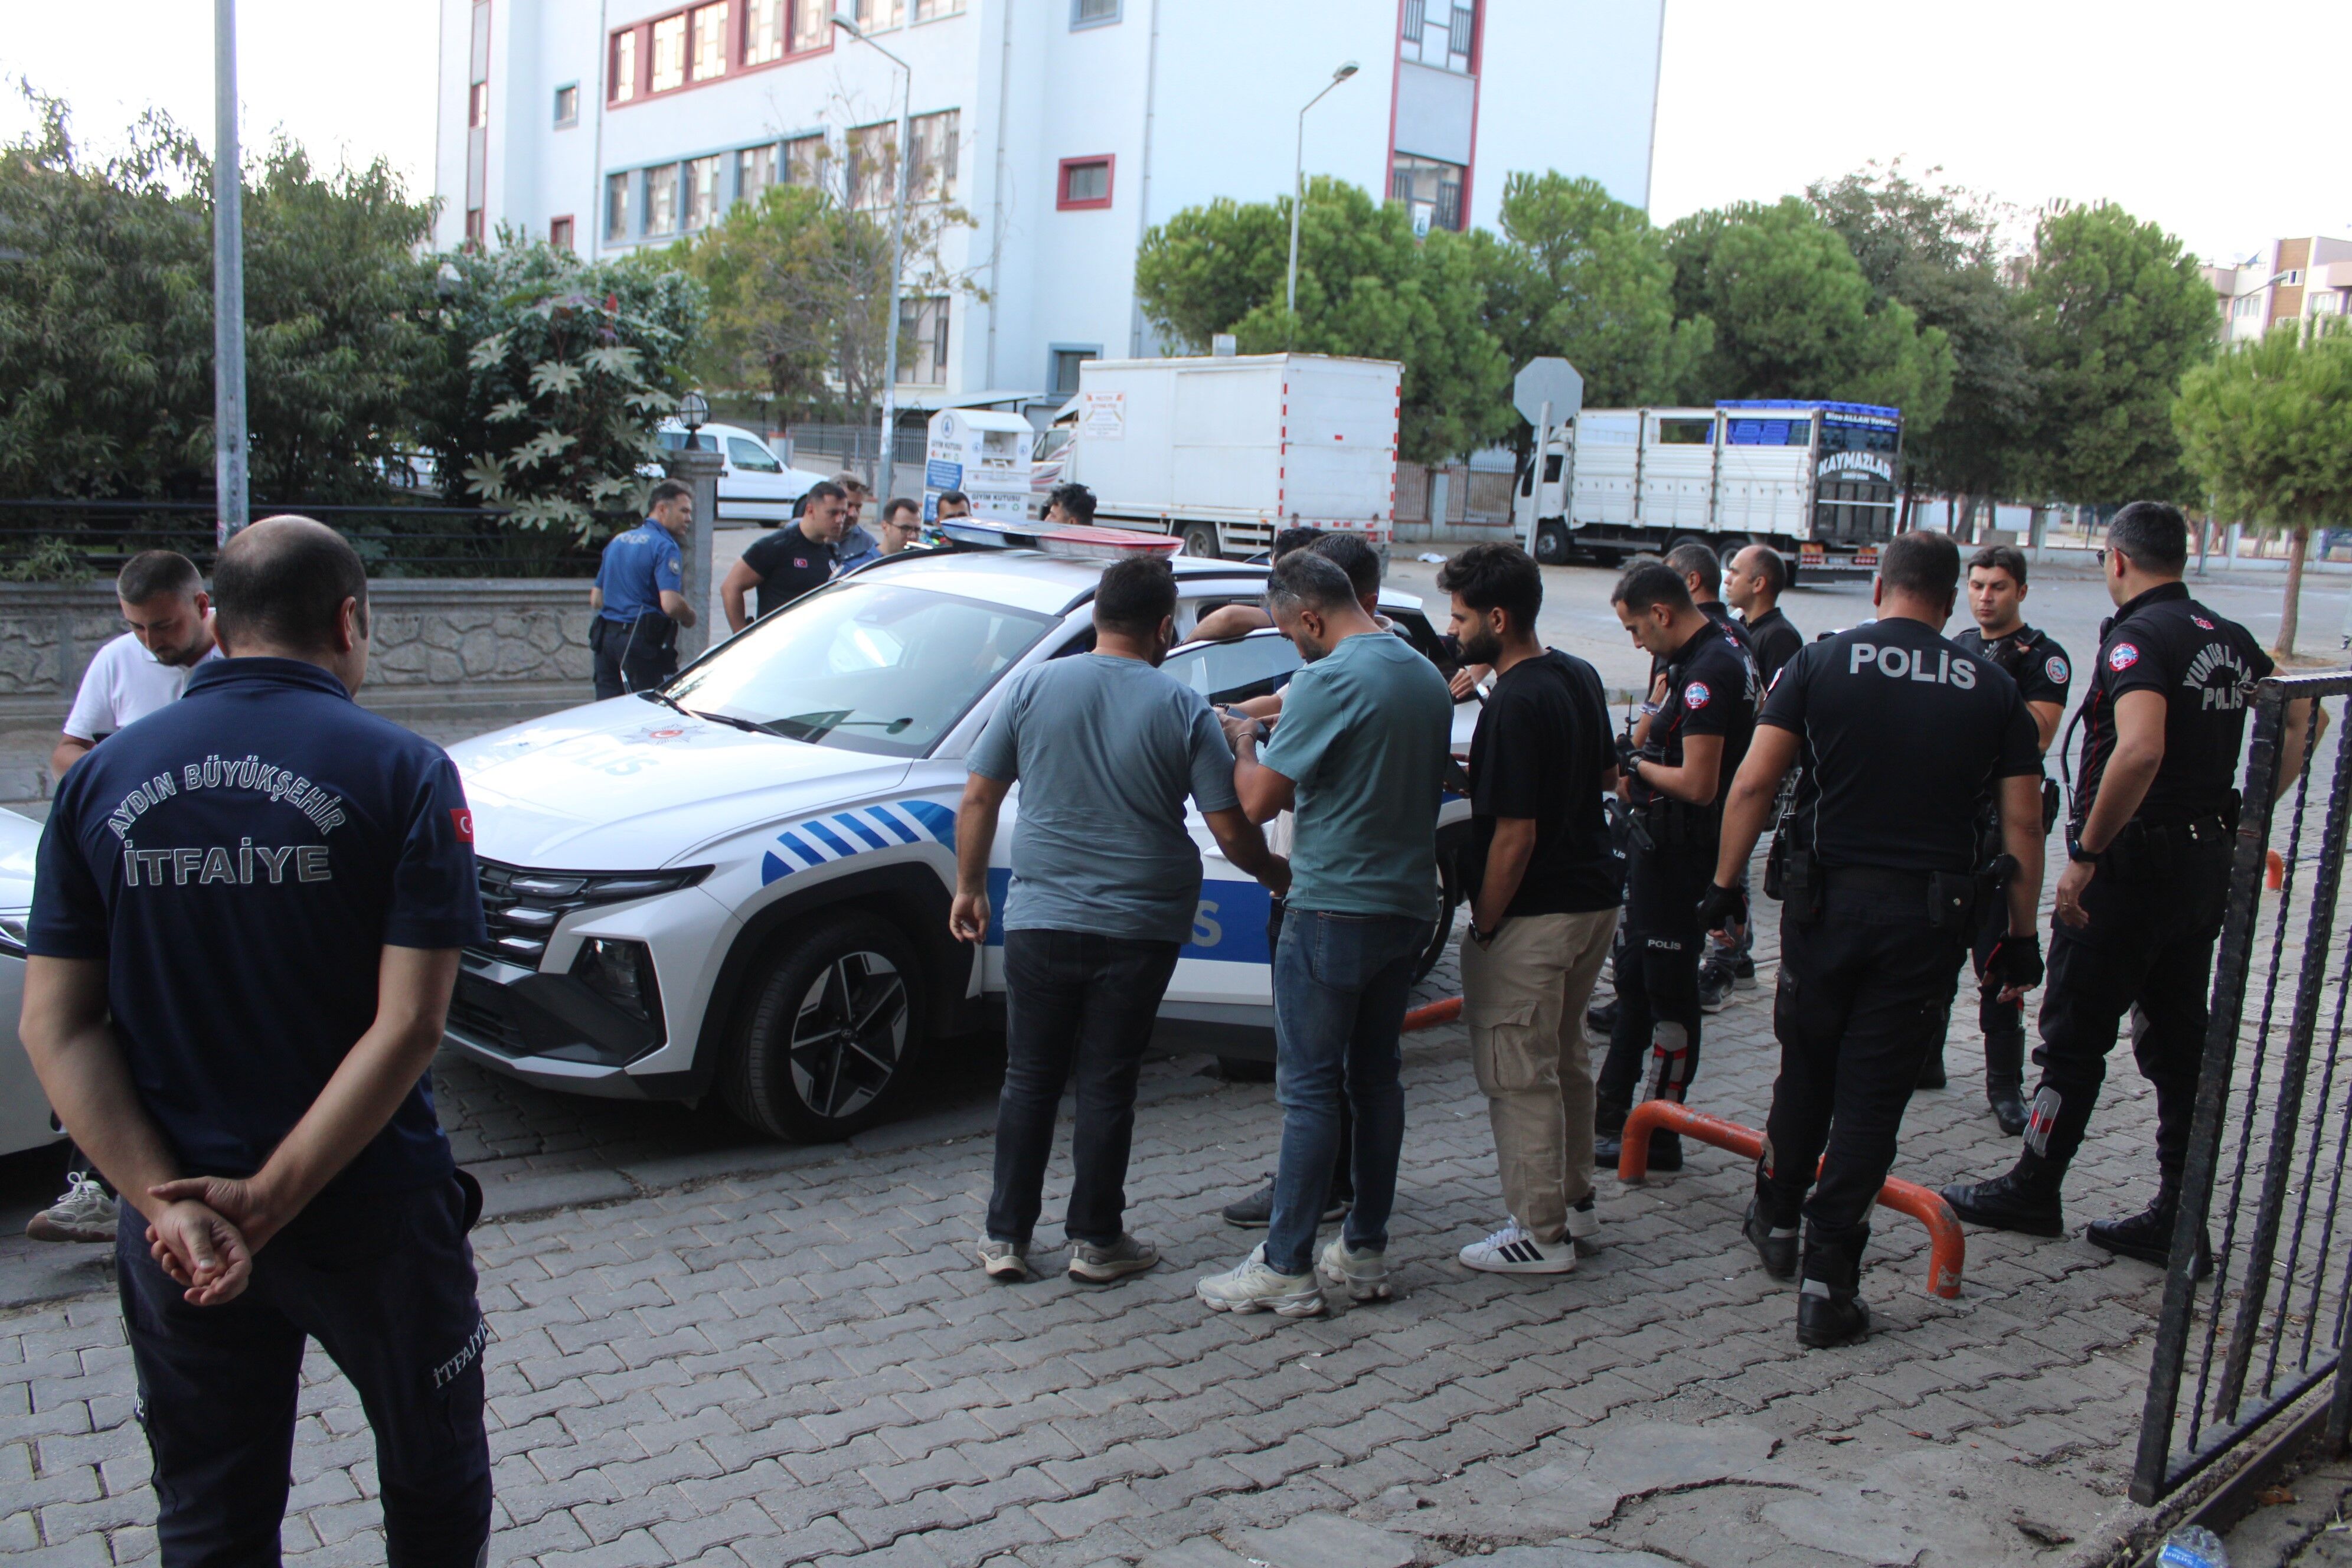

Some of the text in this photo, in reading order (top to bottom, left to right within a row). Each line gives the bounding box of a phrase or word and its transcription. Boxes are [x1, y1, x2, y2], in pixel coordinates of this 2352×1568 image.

[1818, 452, 1892, 482] KAYMAZLAR
[1849, 643, 1977, 690] POLİS
[2201, 680, 2243, 710] POLİS
[108, 754, 347, 840] AYDIN BÜYÜKŞEHİR
[123, 837, 332, 887] İTFAİYE
[1647, 939, 1681, 950] POLİS
